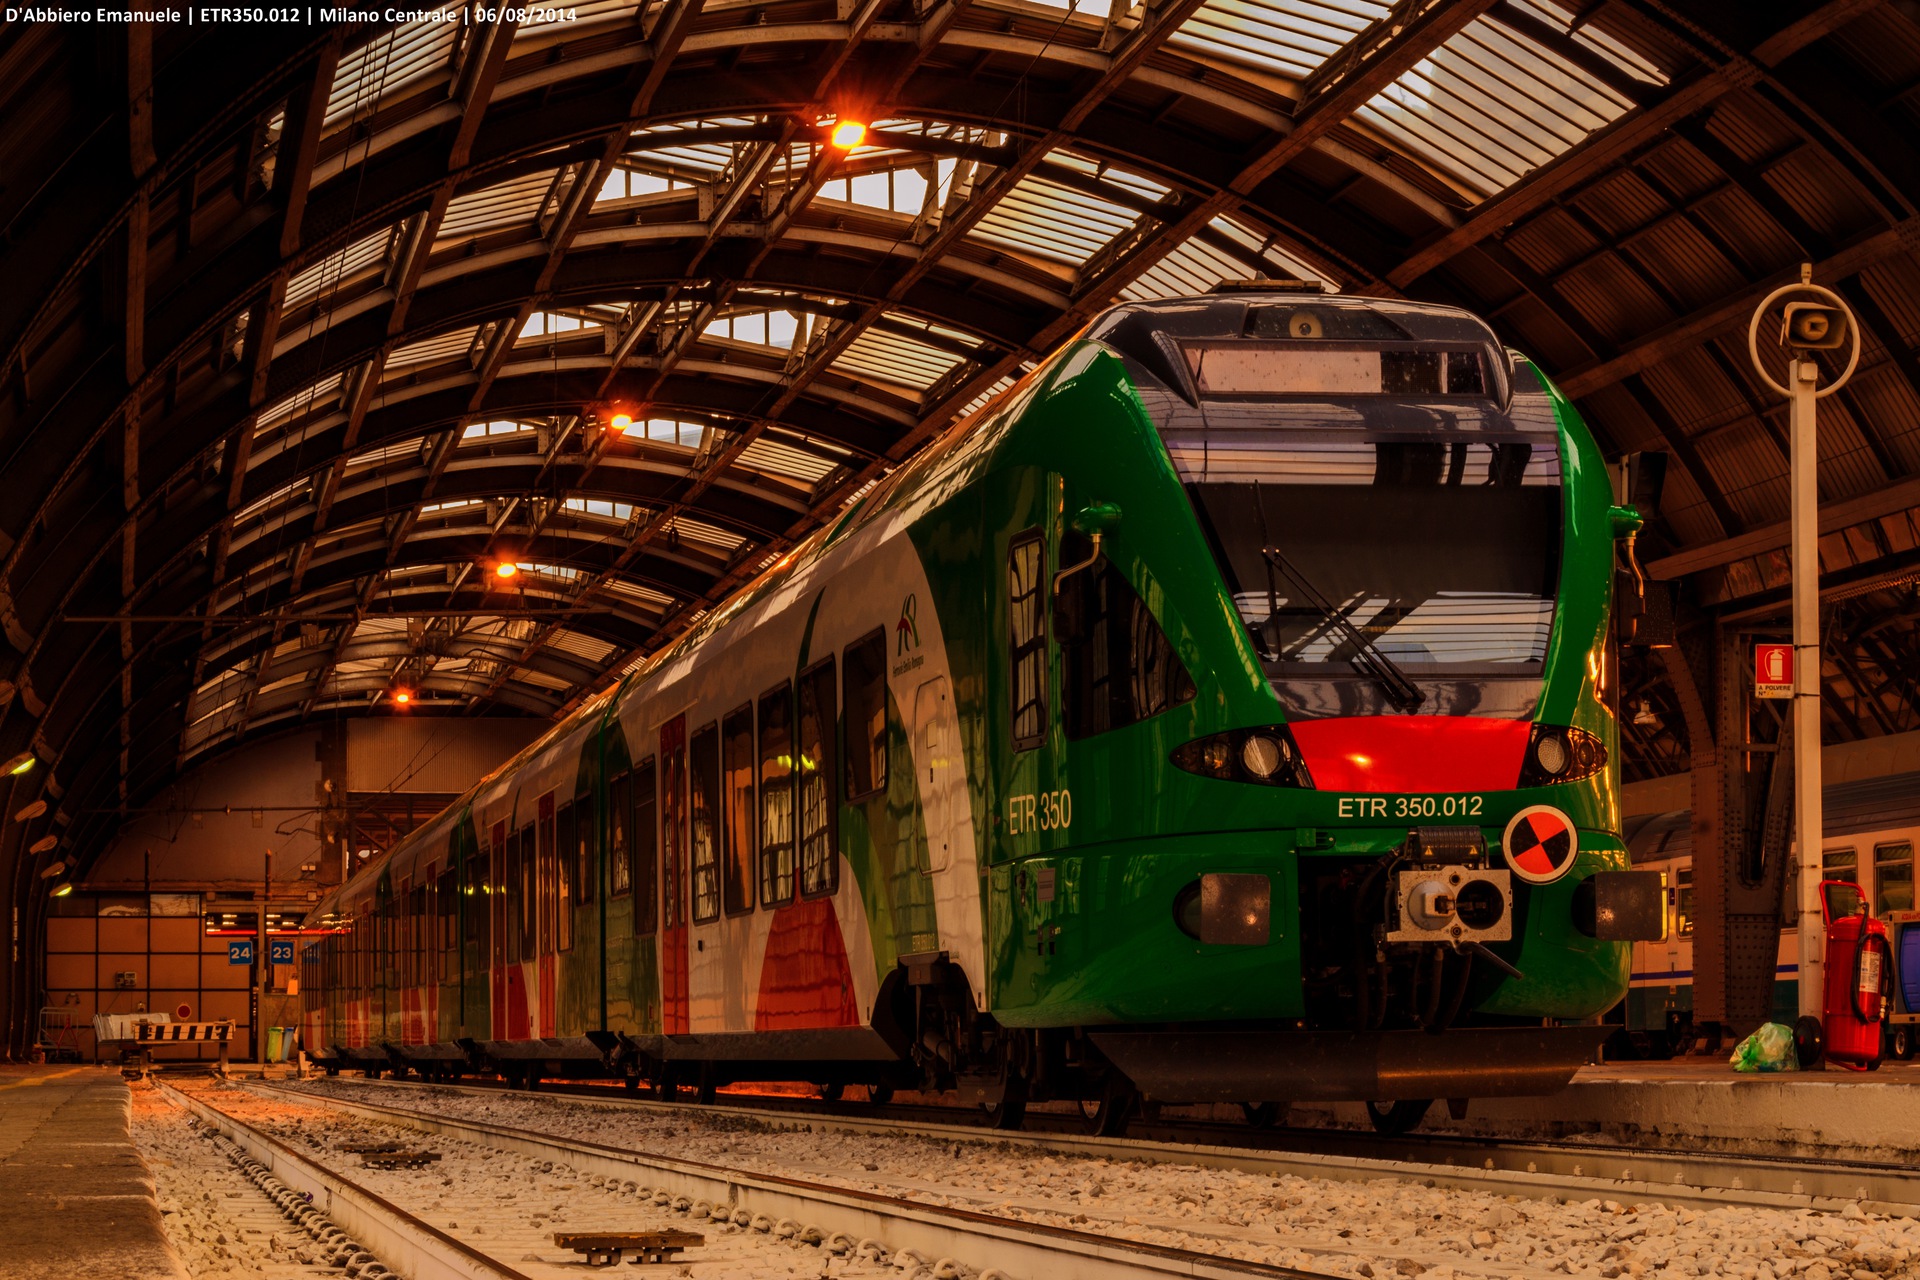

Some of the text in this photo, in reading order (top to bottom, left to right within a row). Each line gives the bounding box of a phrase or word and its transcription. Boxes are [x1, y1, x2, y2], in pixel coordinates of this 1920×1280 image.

[1009, 789, 1073, 836] ETR 350
[1338, 795, 1483, 818] ETR 350.012
[231, 946, 251, 960] 24
[272, 946, 292, 960] 23
